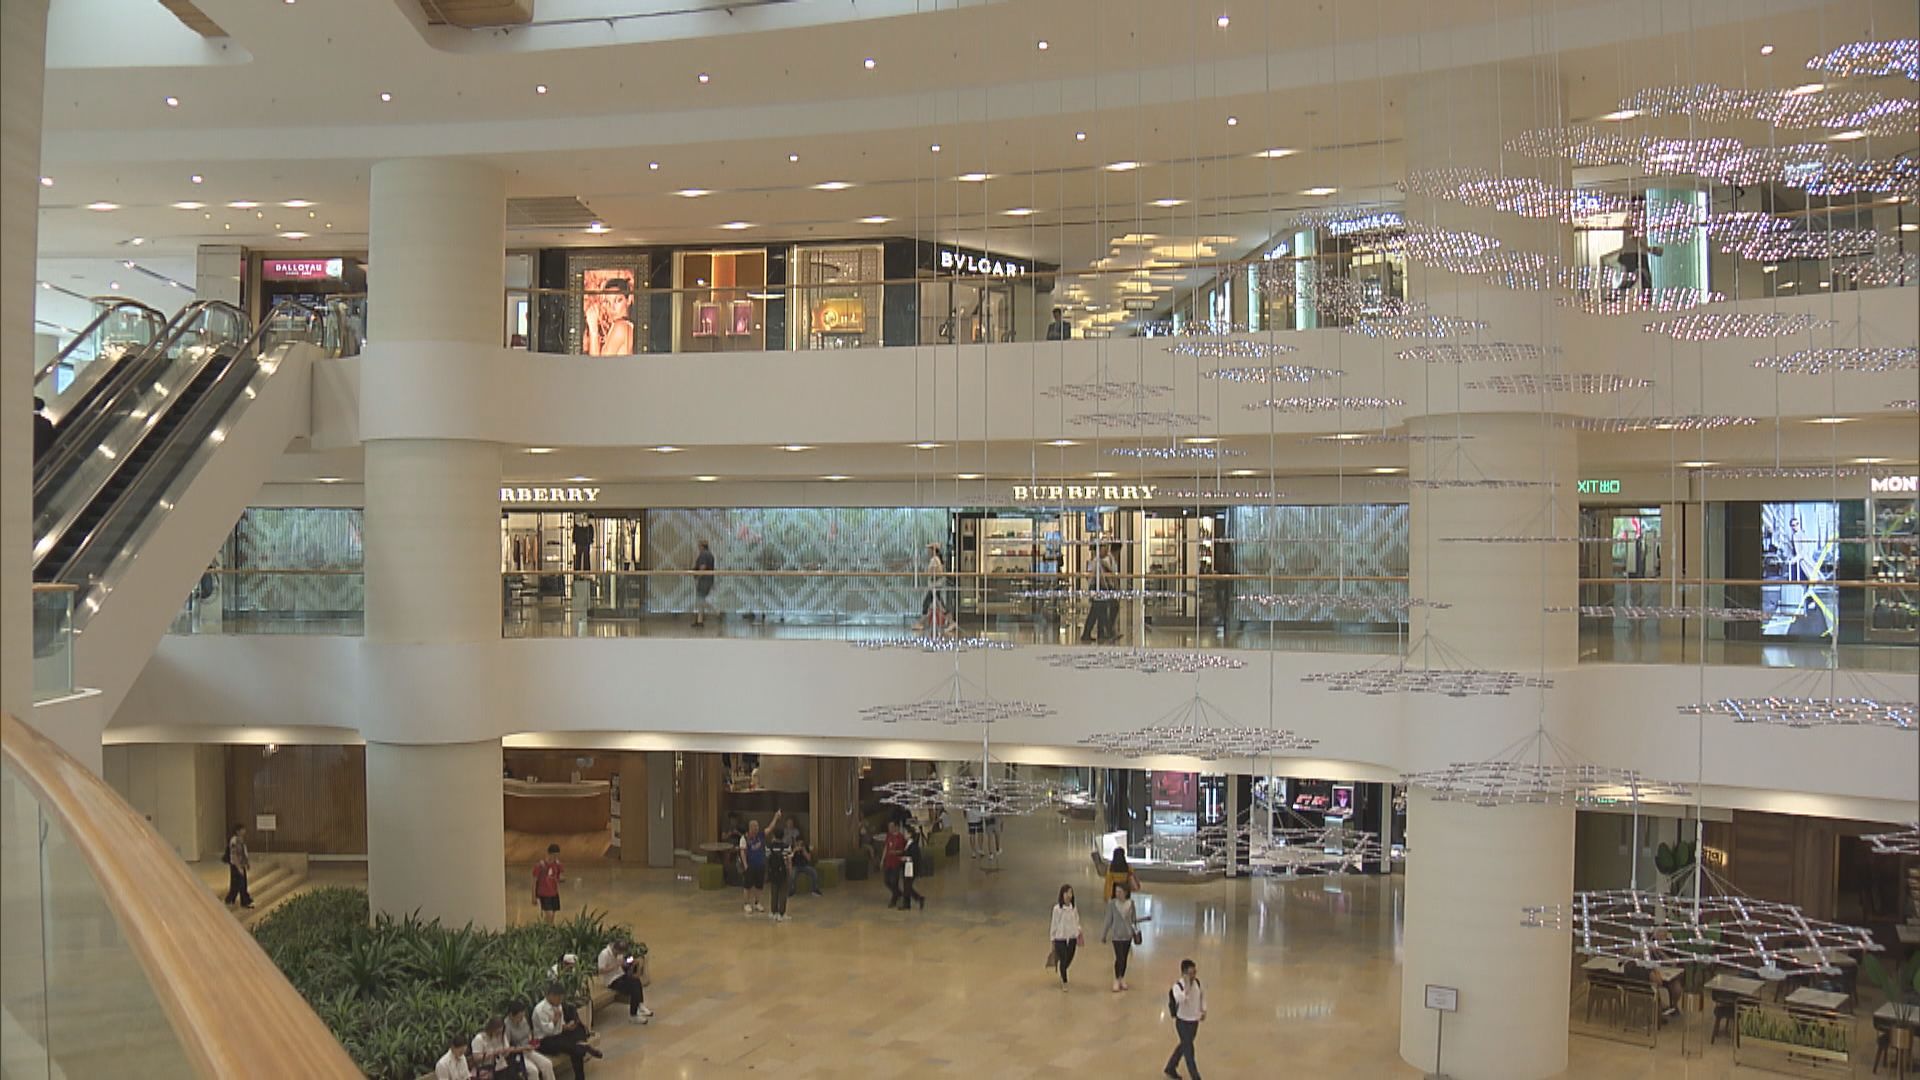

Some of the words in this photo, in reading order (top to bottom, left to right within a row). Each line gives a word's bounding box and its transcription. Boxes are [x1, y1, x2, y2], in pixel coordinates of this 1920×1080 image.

[941, 251, 1025, 277] BVLGARI
[500, 488, 600, 501] RBERRY
[1013, 486, 1157, 500] BURBERRY
